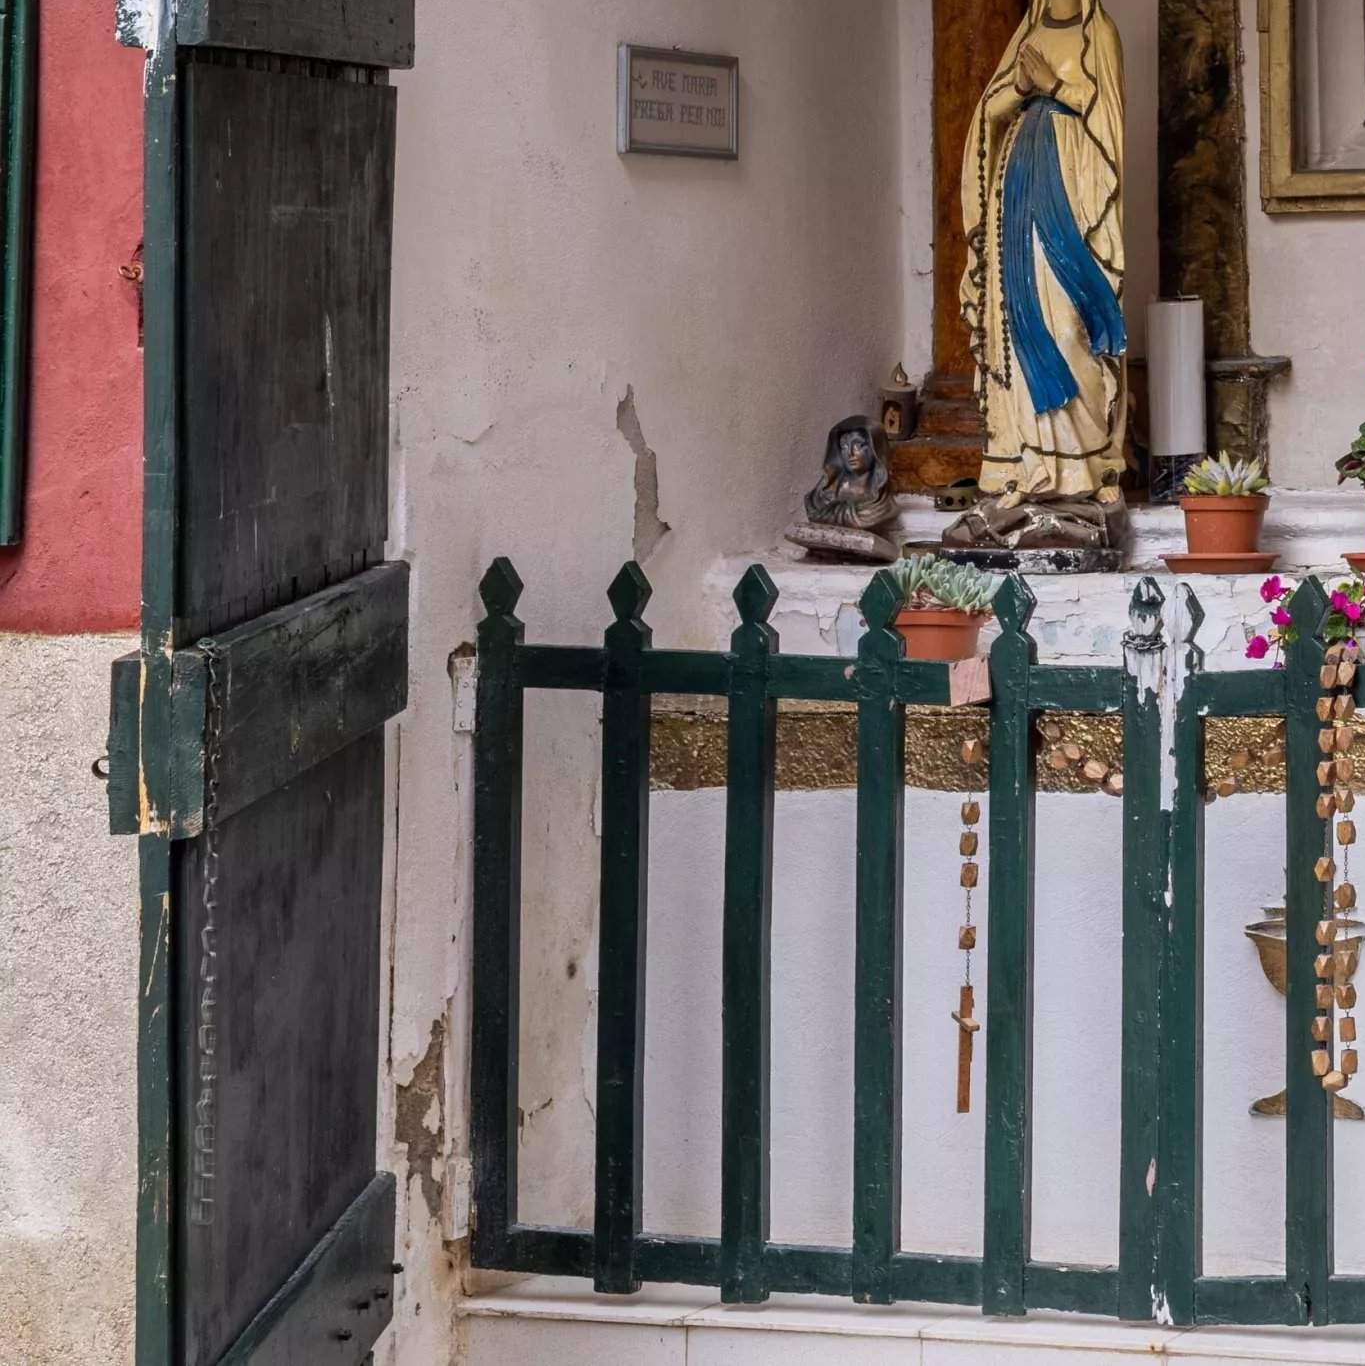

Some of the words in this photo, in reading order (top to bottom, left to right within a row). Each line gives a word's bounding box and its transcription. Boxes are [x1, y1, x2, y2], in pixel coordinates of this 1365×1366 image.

[651, 69, 678, 92] AVE
[682, 73, 718, 98] MARIA
[633, 97, 673, 123] PREGA
[680, 104, 704, 126] PER
